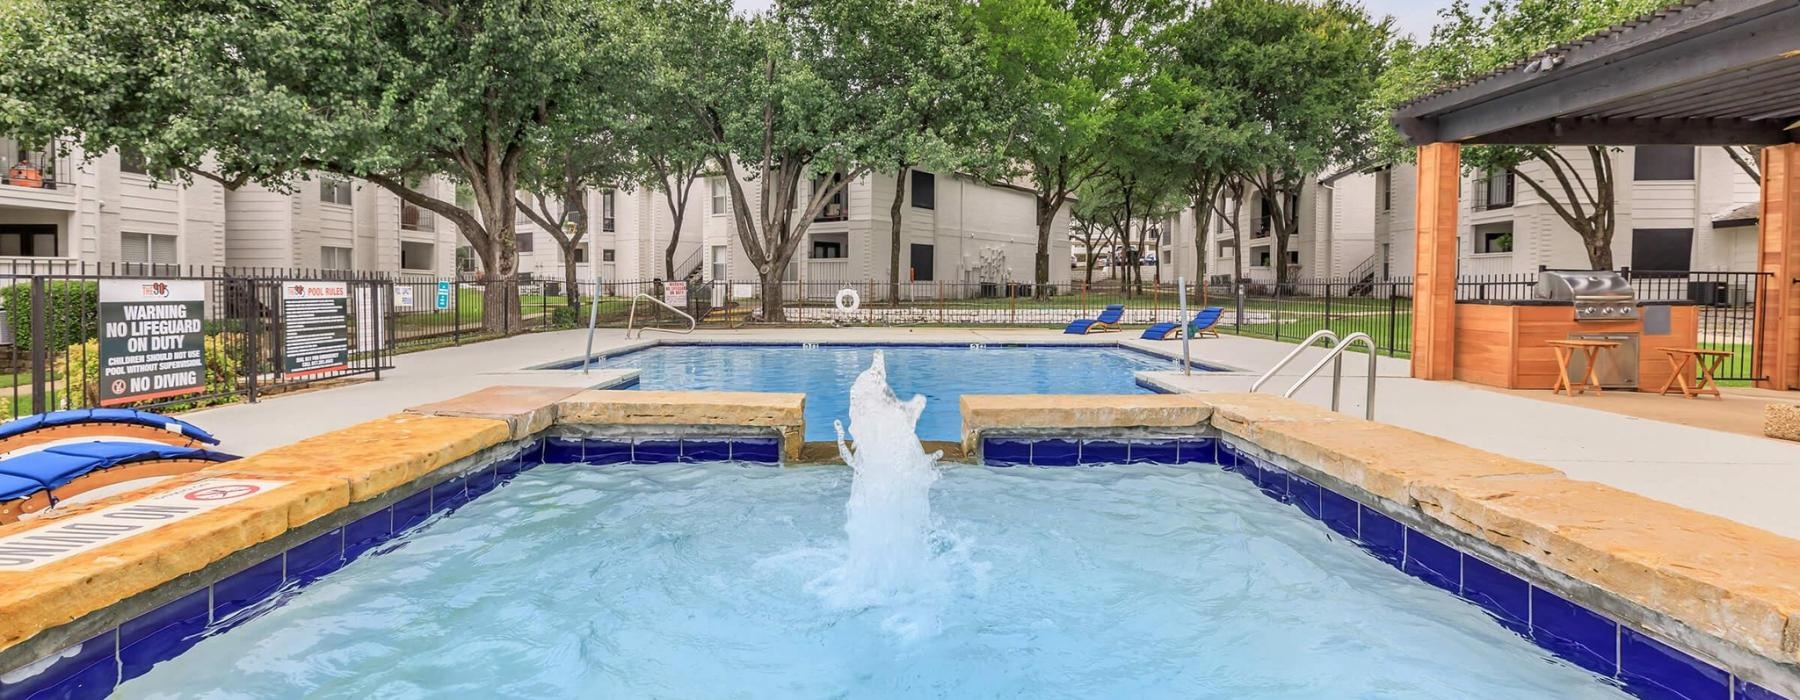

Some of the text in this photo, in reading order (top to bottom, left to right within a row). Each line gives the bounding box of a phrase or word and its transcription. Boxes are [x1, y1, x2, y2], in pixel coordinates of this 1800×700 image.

[308, 287, 343, 296] POOL RULES
[123, 304, 187, 320] WARNING
[106, 319, 201, 338] NO LIFEGUARD
[127, 335, 185, 353] ON DUTY
[108, 349, 200, 366] CHILDREN SHOULD NOT USE
[105, 367, 126, 376] POOL
[127, 363, 158, 374] WITHOUT
[130, 371, 197, 393] NO DIVING
[102, 504, 200, 520] NO
